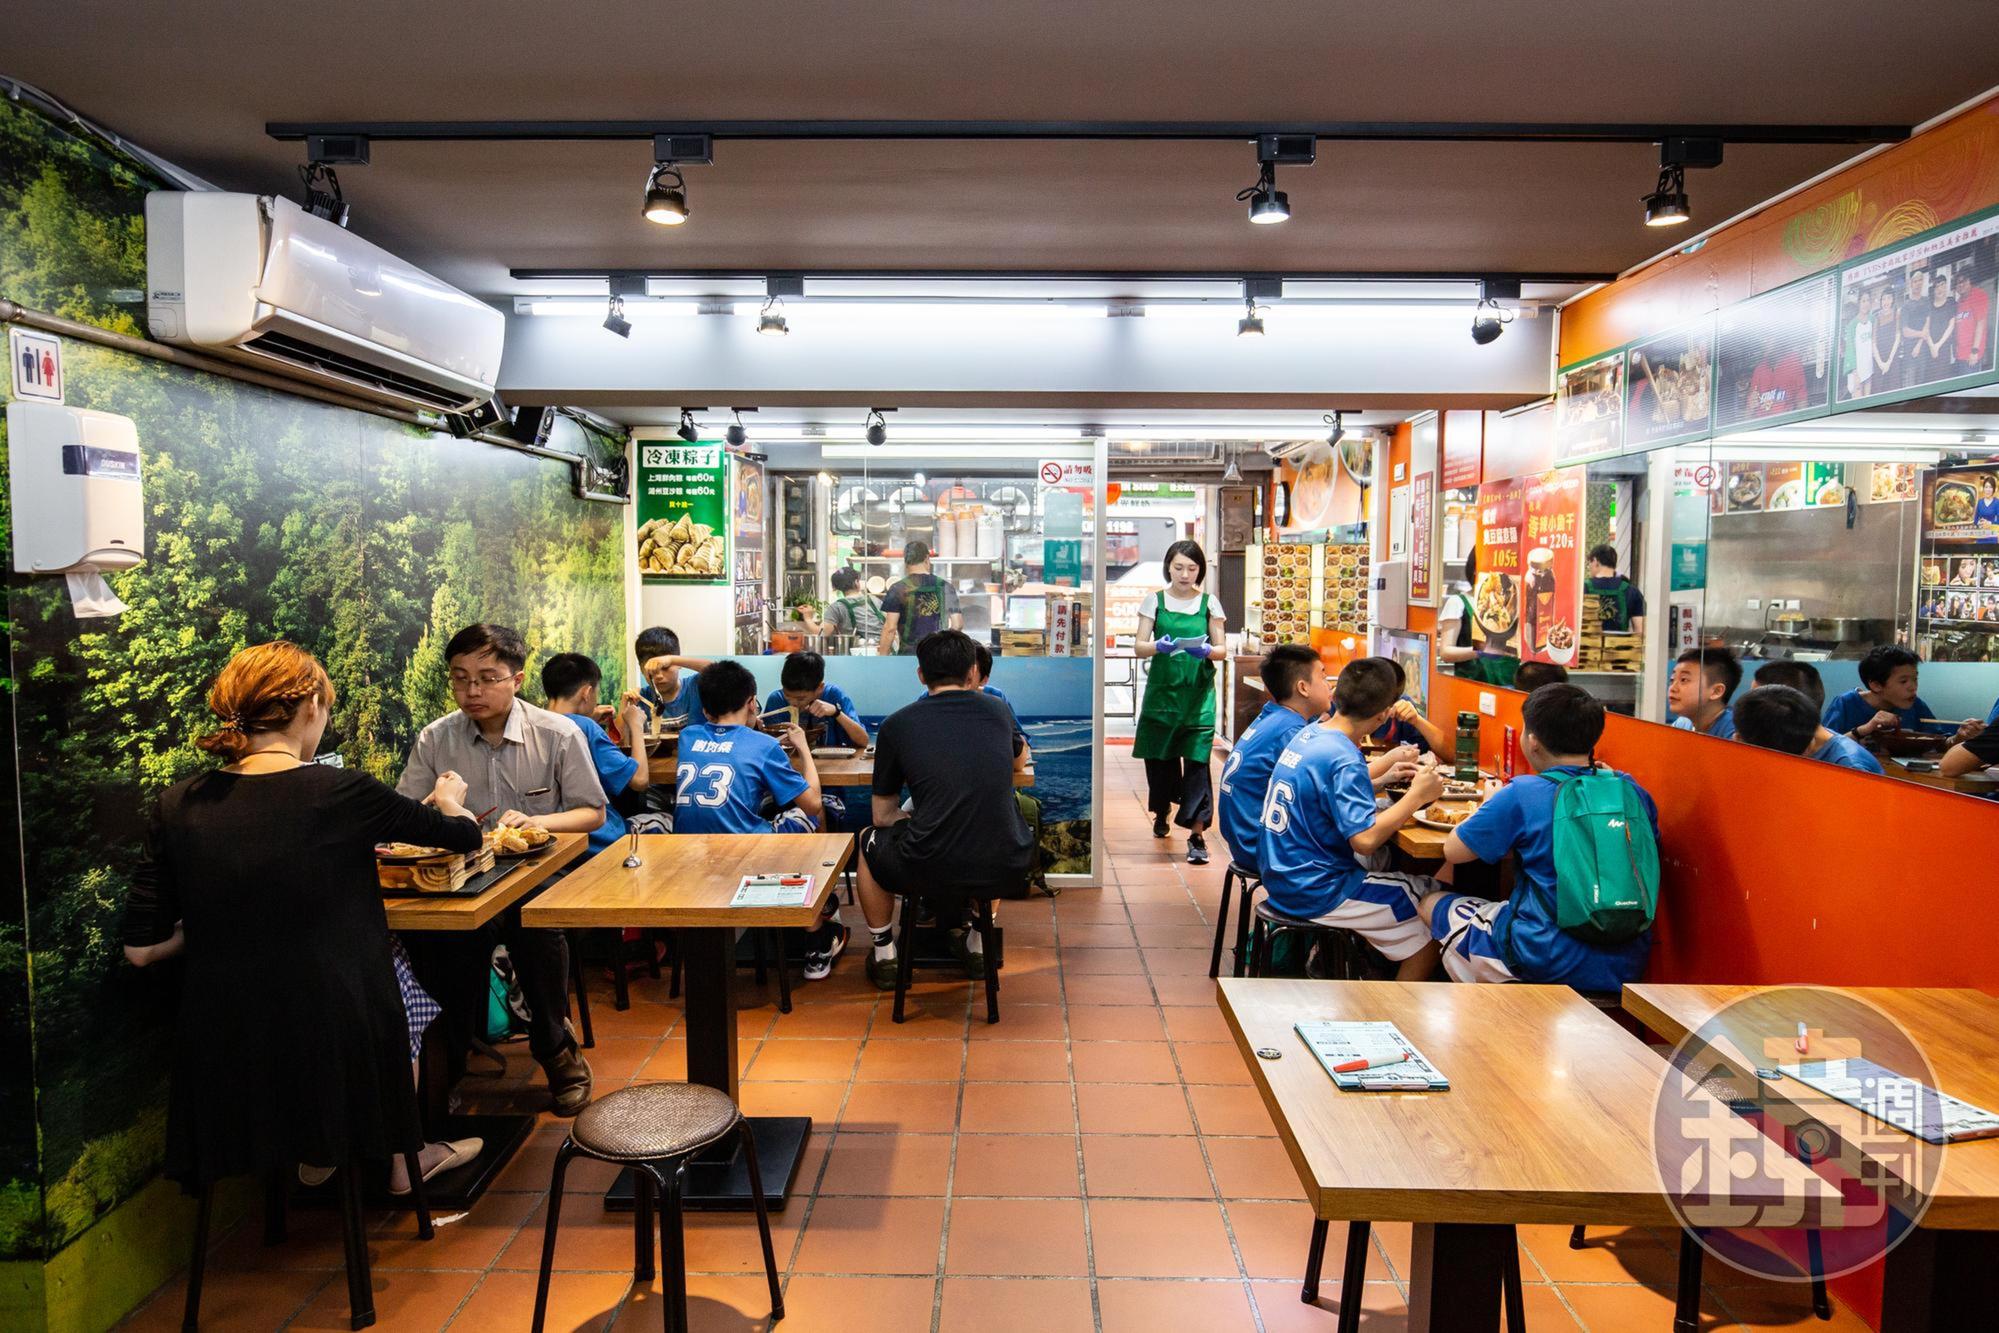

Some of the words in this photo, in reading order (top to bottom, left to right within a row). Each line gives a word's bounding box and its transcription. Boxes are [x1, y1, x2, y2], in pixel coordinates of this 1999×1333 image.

[647, 448, 716, 465] 冷凍粽子
[1492, 548, 1518, 568] 105元
[1055, 604, 1067, 654] 請先付款
[676, 761, 736, 808] 23
